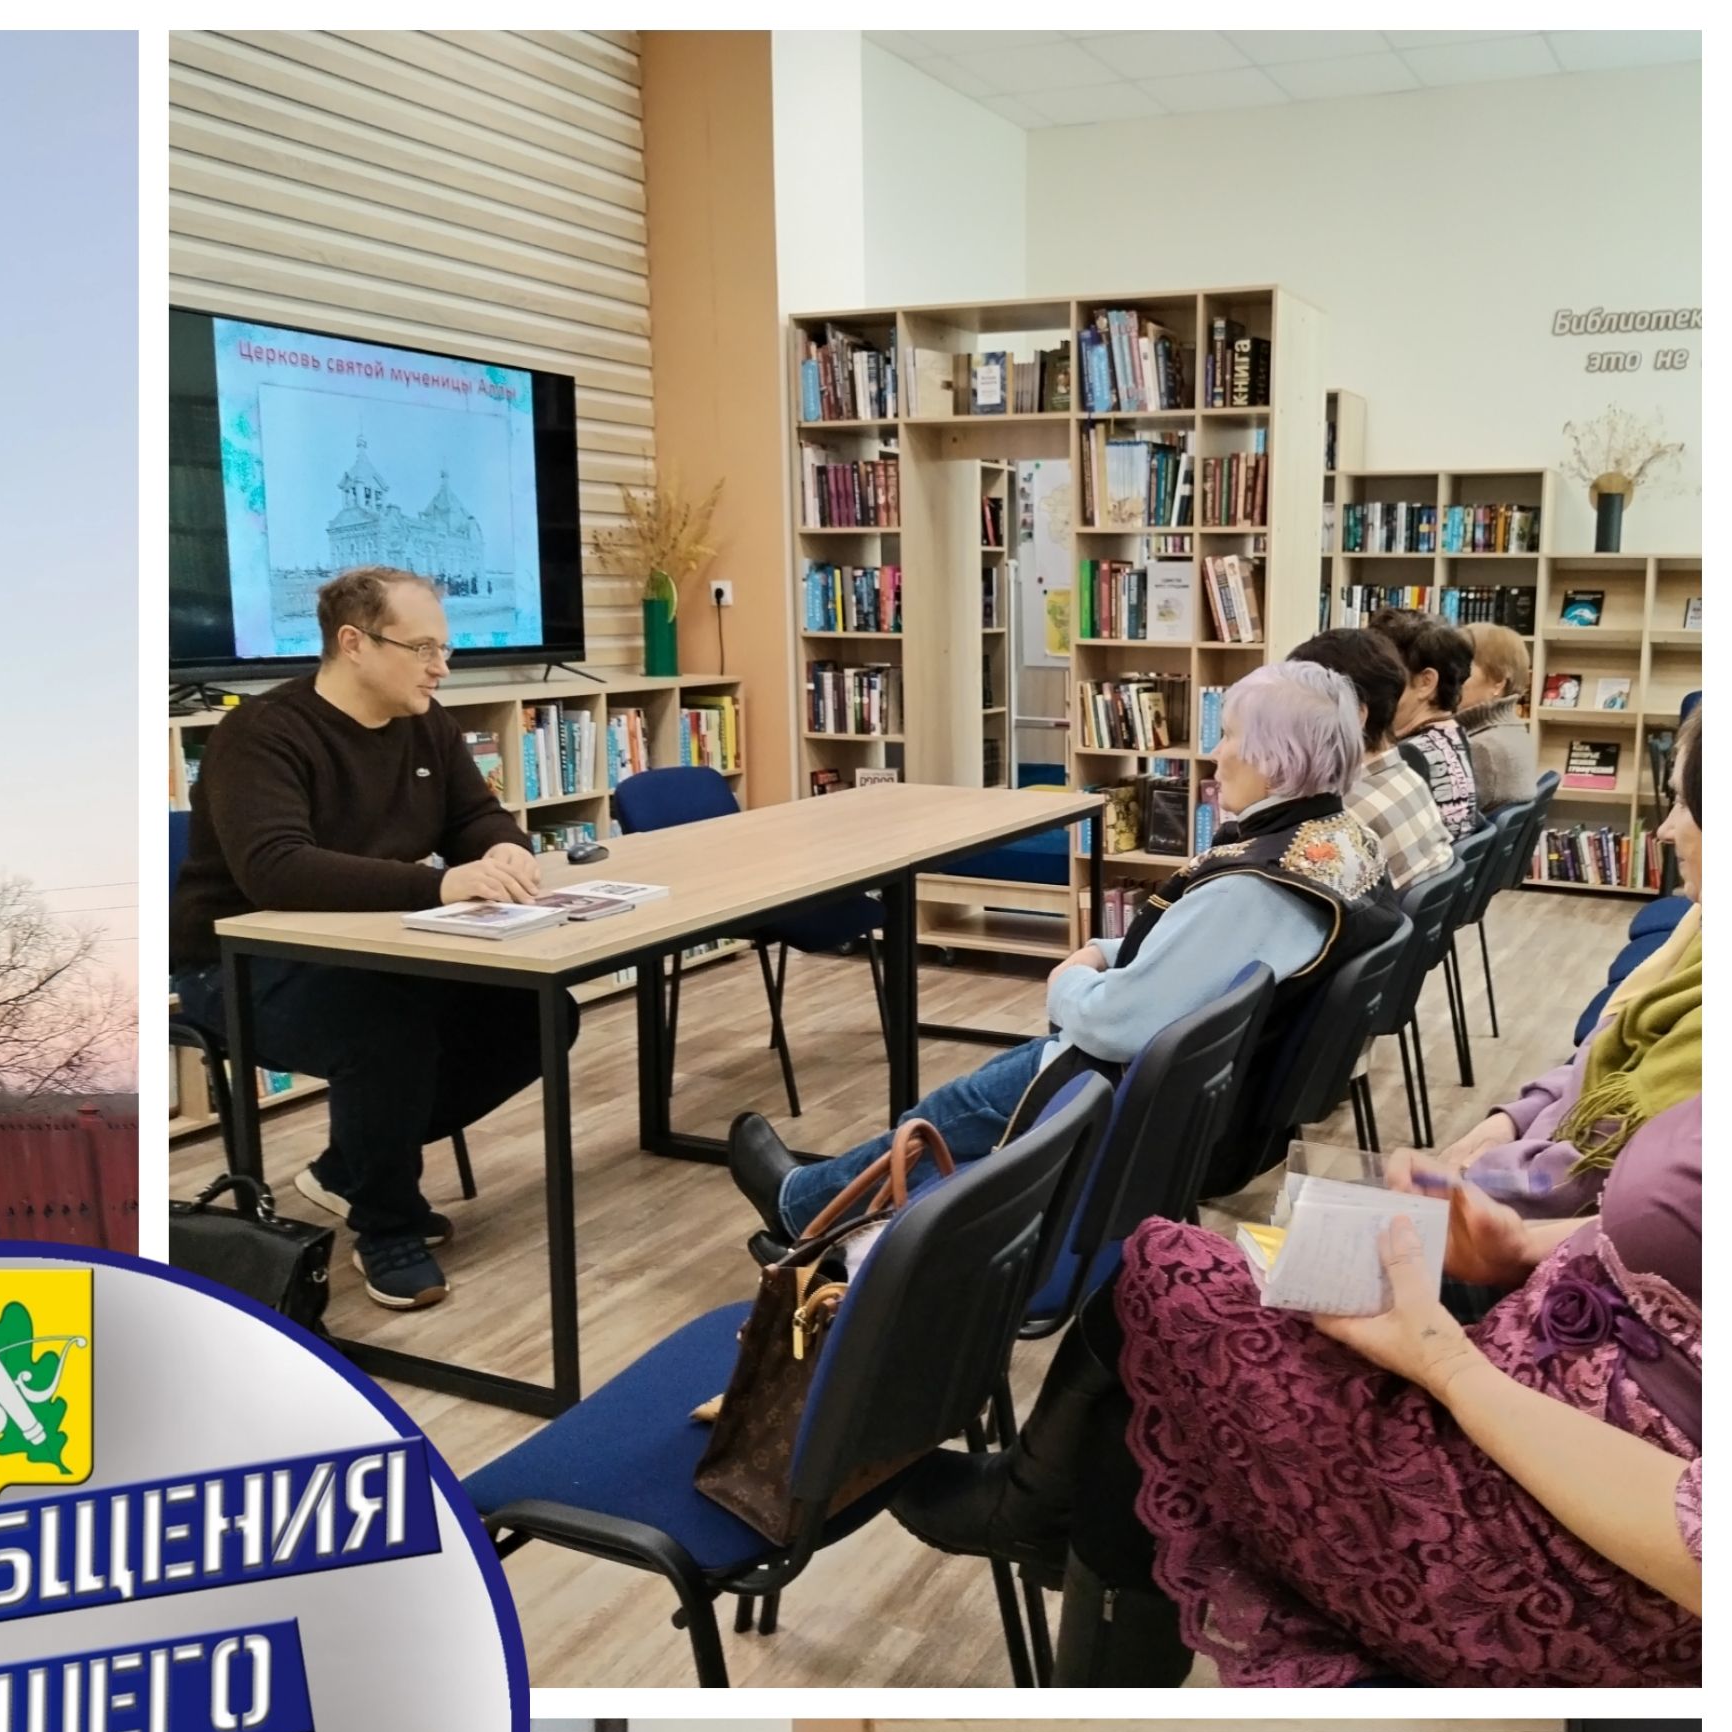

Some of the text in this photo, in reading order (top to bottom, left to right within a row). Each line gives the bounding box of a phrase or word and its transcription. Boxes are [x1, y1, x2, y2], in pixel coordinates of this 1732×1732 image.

[237, 340, 516, 400] Церковь святой мученицы Аллы
[1585, 348, 1689, 373] это не
